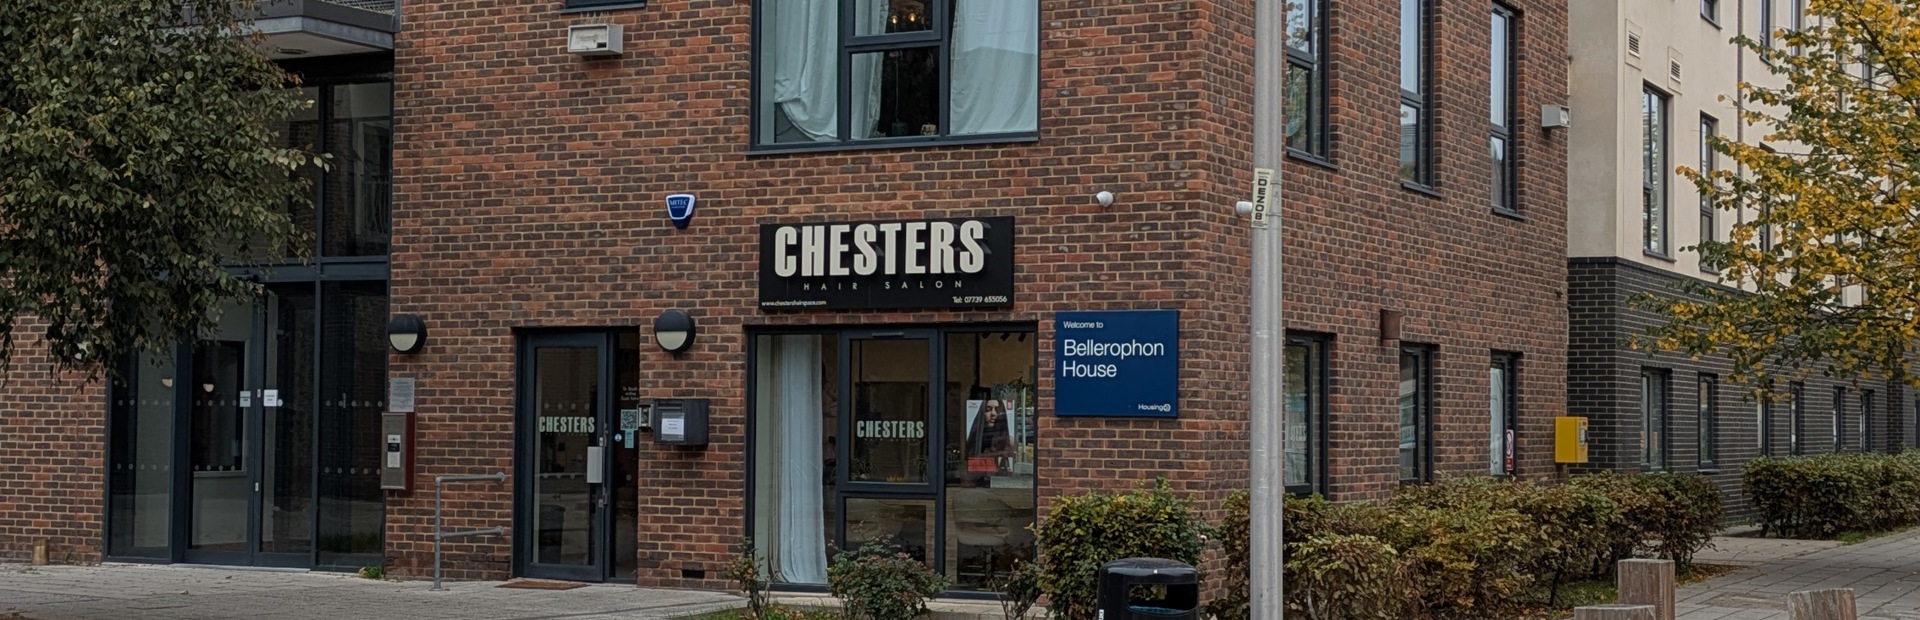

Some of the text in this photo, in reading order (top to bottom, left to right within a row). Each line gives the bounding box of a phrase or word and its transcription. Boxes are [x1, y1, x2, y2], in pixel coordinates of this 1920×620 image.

[774, 220, 985, 277] CHESTERS
[803, 280, 962, 291] HAIR SALON
[964, 296, 983, 304] 07739
[984, 295, 1008, 303] 655056
[1063, 321, 1104, 329] Welcome to
[1064, 339, 1165, 360] Bellerophon
[1062, 360, 1118, 378] House
[538, 416, 596, 434] CHESTERS
[856, 420, 925, 439] CHESTERS
